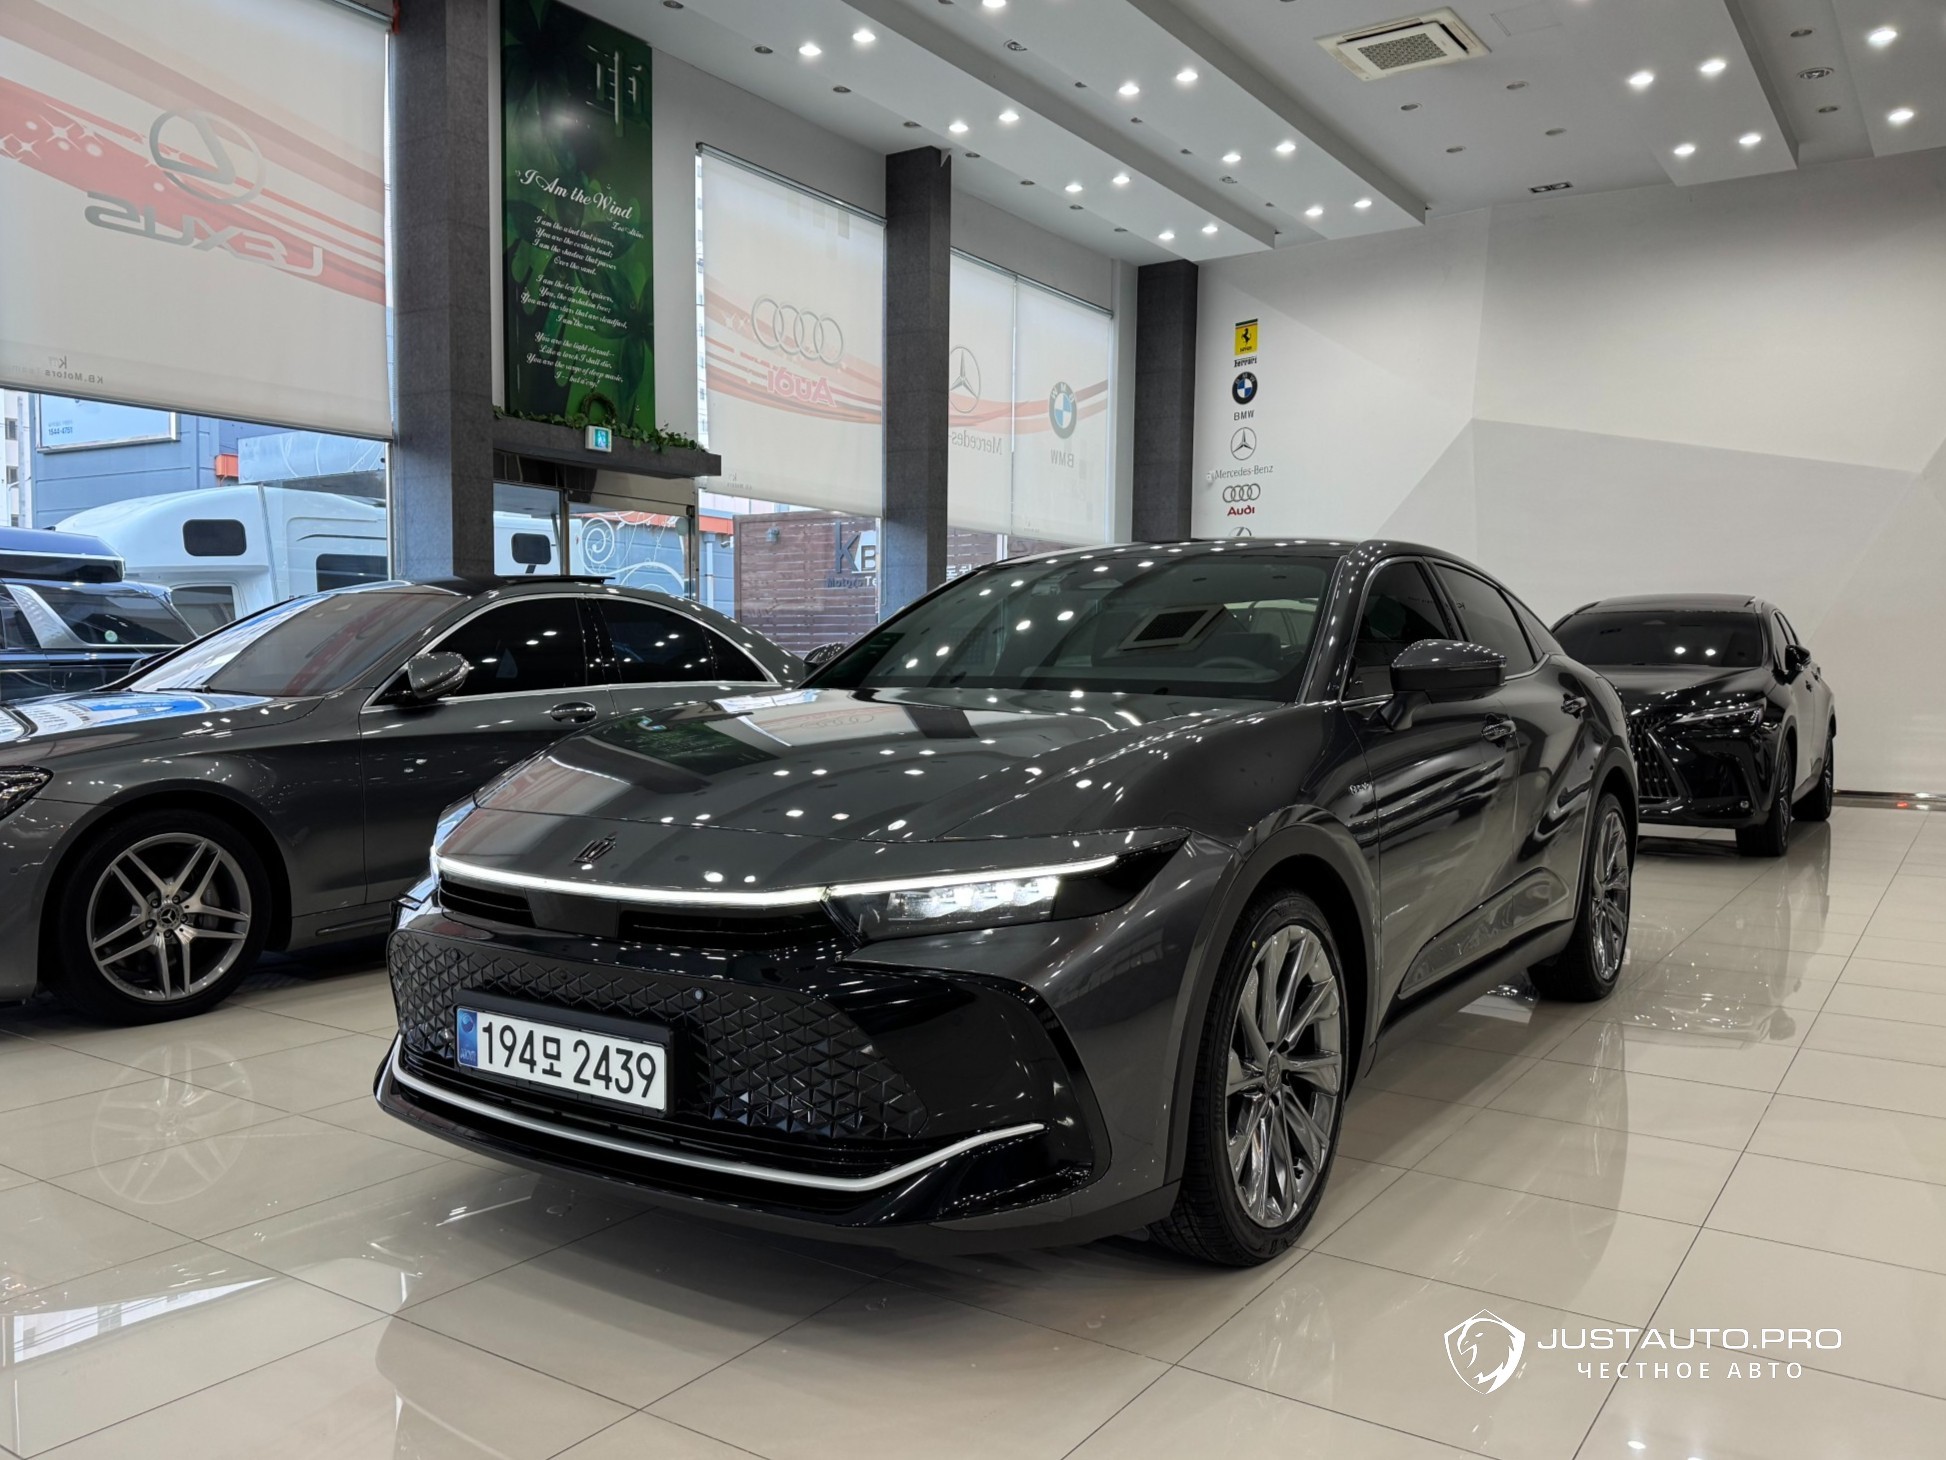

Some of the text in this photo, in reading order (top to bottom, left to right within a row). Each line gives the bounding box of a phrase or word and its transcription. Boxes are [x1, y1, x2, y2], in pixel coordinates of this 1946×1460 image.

[520, 169, 633, 219] I Am the Wind
[535, 227, 551, 238] You
[563, 237, 574, 246] the
[541, 220, 552, 228] am
[552, 221, 563, 231] the
[563, 226, 580, 236] wind
[580, 230, 593, 240] that
[550, 244, 561, 253] the
[584, 255, 598, 264] that
[569, 261, 580, 270] the
[543, 278, 554, 286] am
[554, 280, 565, 289] the
[578, 287, 592, 297] that
[556, 292, 567, 301] the
[520, 291, 536, 304] You
[548, 301, 559, 310] the
[574, 308, 589, 318] that
[534, 331, 550, 342] You
[562, 339, 572, 348] the
[526, 352, 542, 364] You
[554, 360, 565, 369] the
[1233, 410, 1255, 420] BMW
[1214, 465, 1273, 479] Mercedes-Benz
[1227, 505, 1255, 516] Audi
[482, 1022, 656, 1098] 194모 2439
